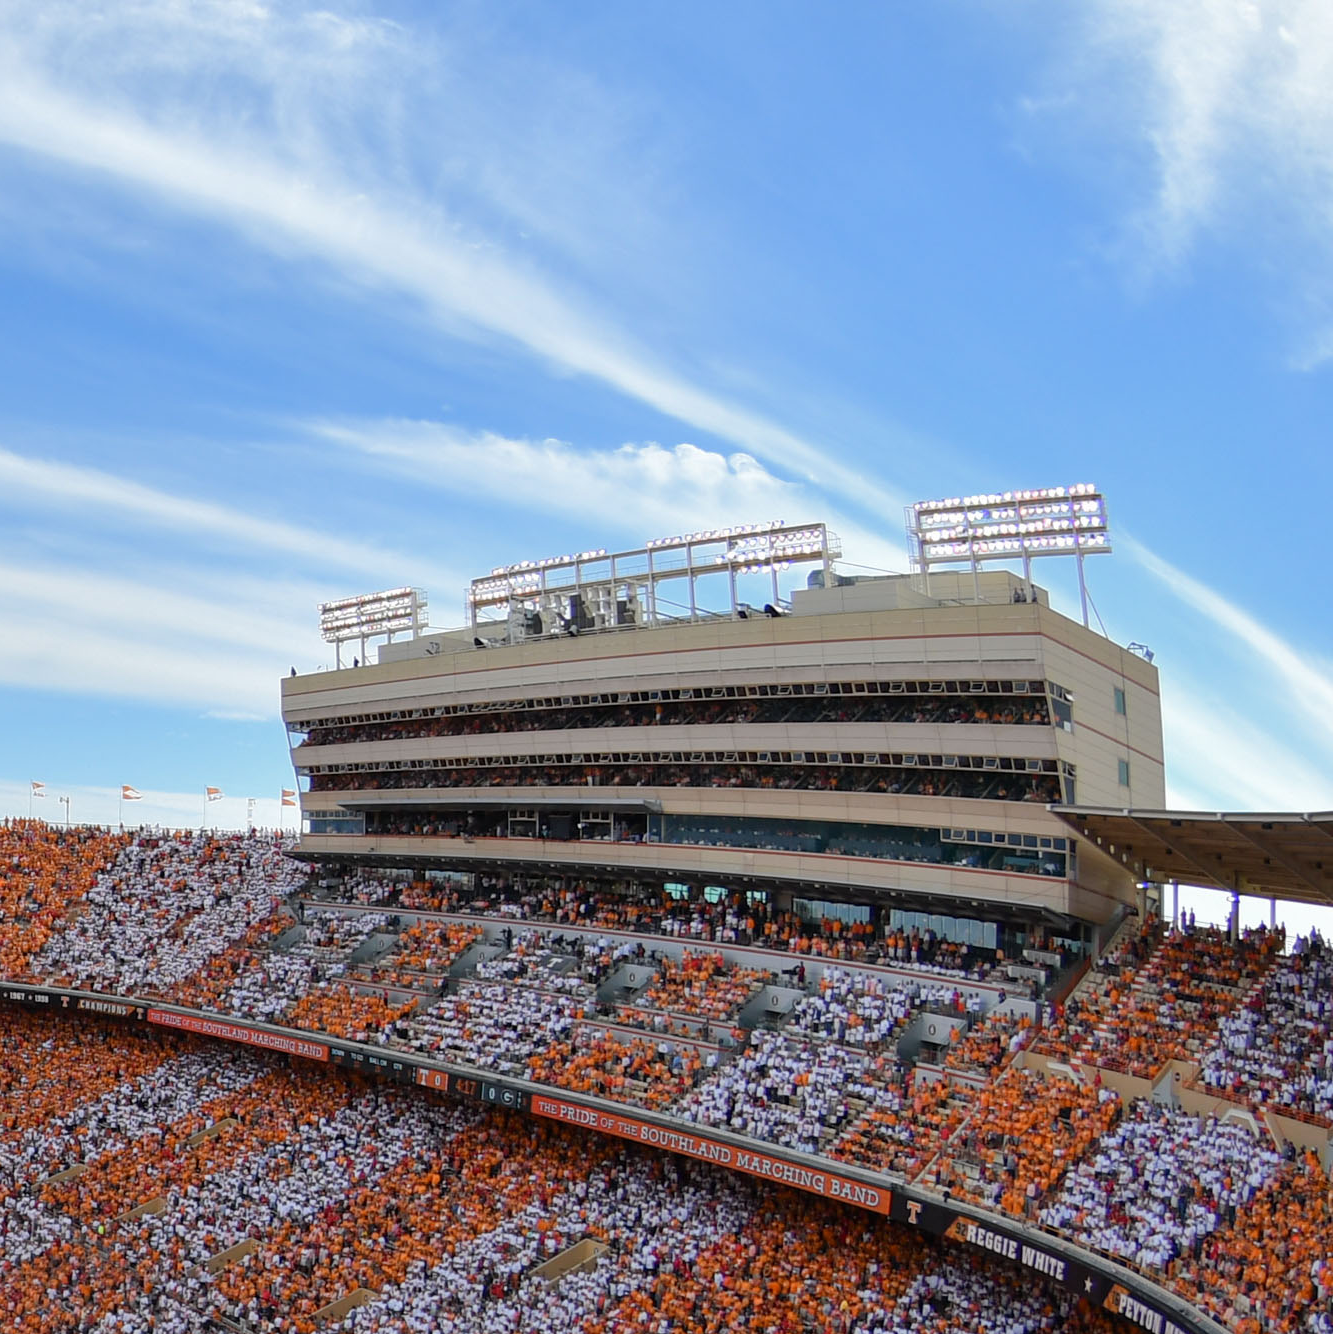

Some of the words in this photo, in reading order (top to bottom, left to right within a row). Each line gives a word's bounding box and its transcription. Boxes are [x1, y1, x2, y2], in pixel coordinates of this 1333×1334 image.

[80, 999, 127, 1015] CHAMPIONS
[161, 1013, 182, 1026] PRIDE
[203, 1022, 249, 1041] SOUTHLAND
[251, 1032, 296, 1051] MARCHING
[298, 1043, 323, 1058] BAND
[538, 1101, 558, 1115] THE
[559, 1105, 598, 1127] PRIDE
[600, 1117, 615, 1129] OF
[618, 1121, 638, 1137] THE
[640, 1126, 732, 1164] SOUTHLAND
[736, 1151, 824, 1194] MARCHING
[830, 1178, 881, 1208] BAND
[967, 1223, 1018, 1260] REGGIE
[1022, 1245, 1065, 1281] WHITE
